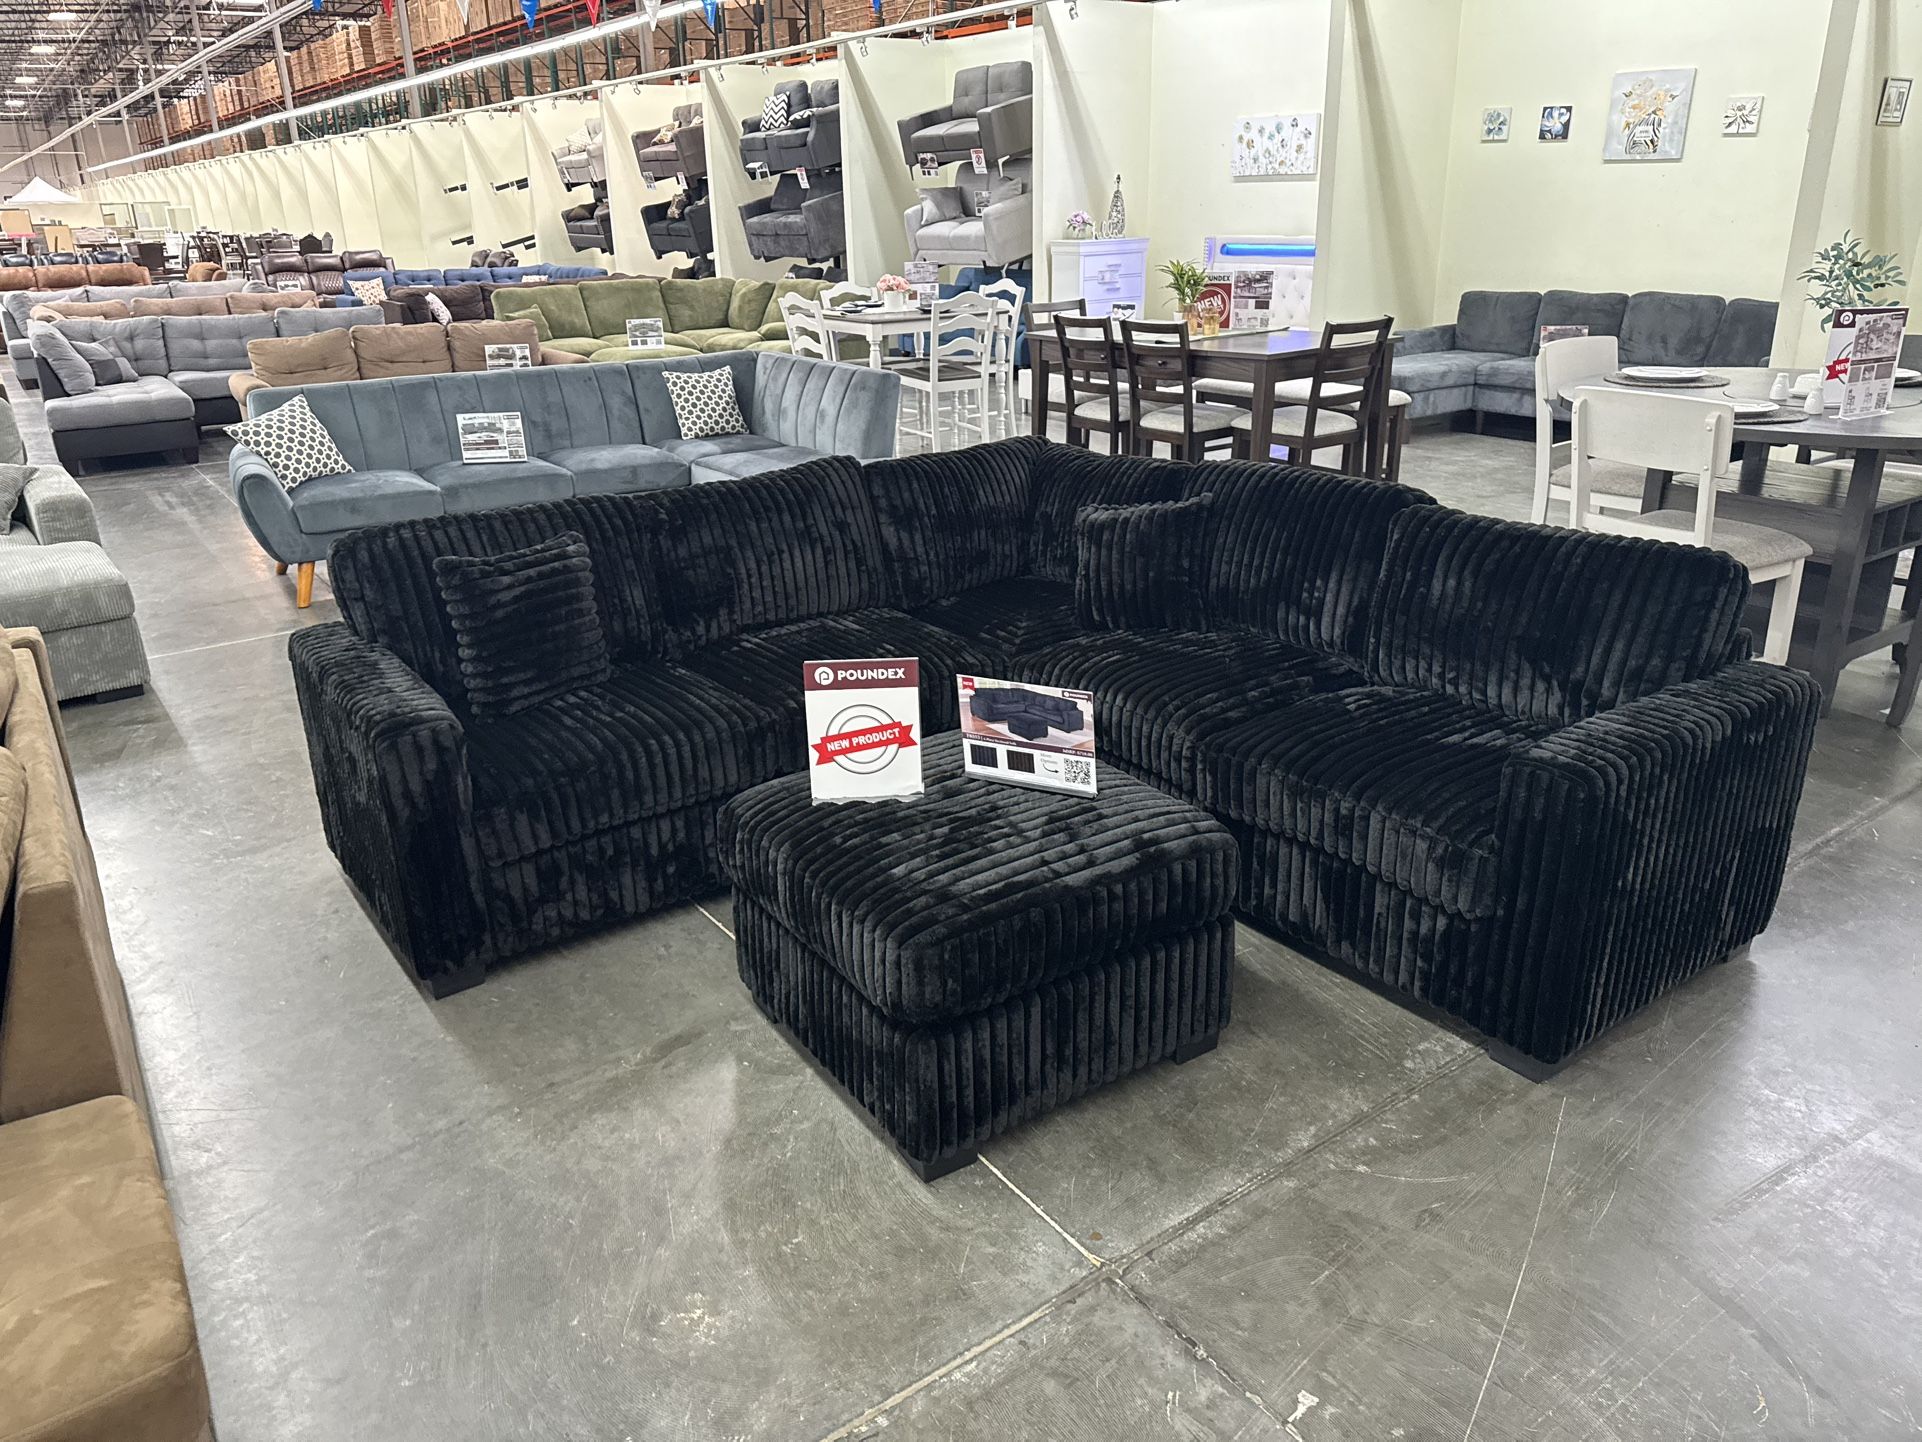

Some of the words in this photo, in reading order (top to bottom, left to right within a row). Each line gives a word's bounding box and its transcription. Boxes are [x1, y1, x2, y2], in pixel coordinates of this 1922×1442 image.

[1196, 294, 1222, 311] NEW
[837, 667, 906, 681] POUNDEX
[826, 738, 850, 752] NEW
[851, 727, 900, 747] PRODUCT
